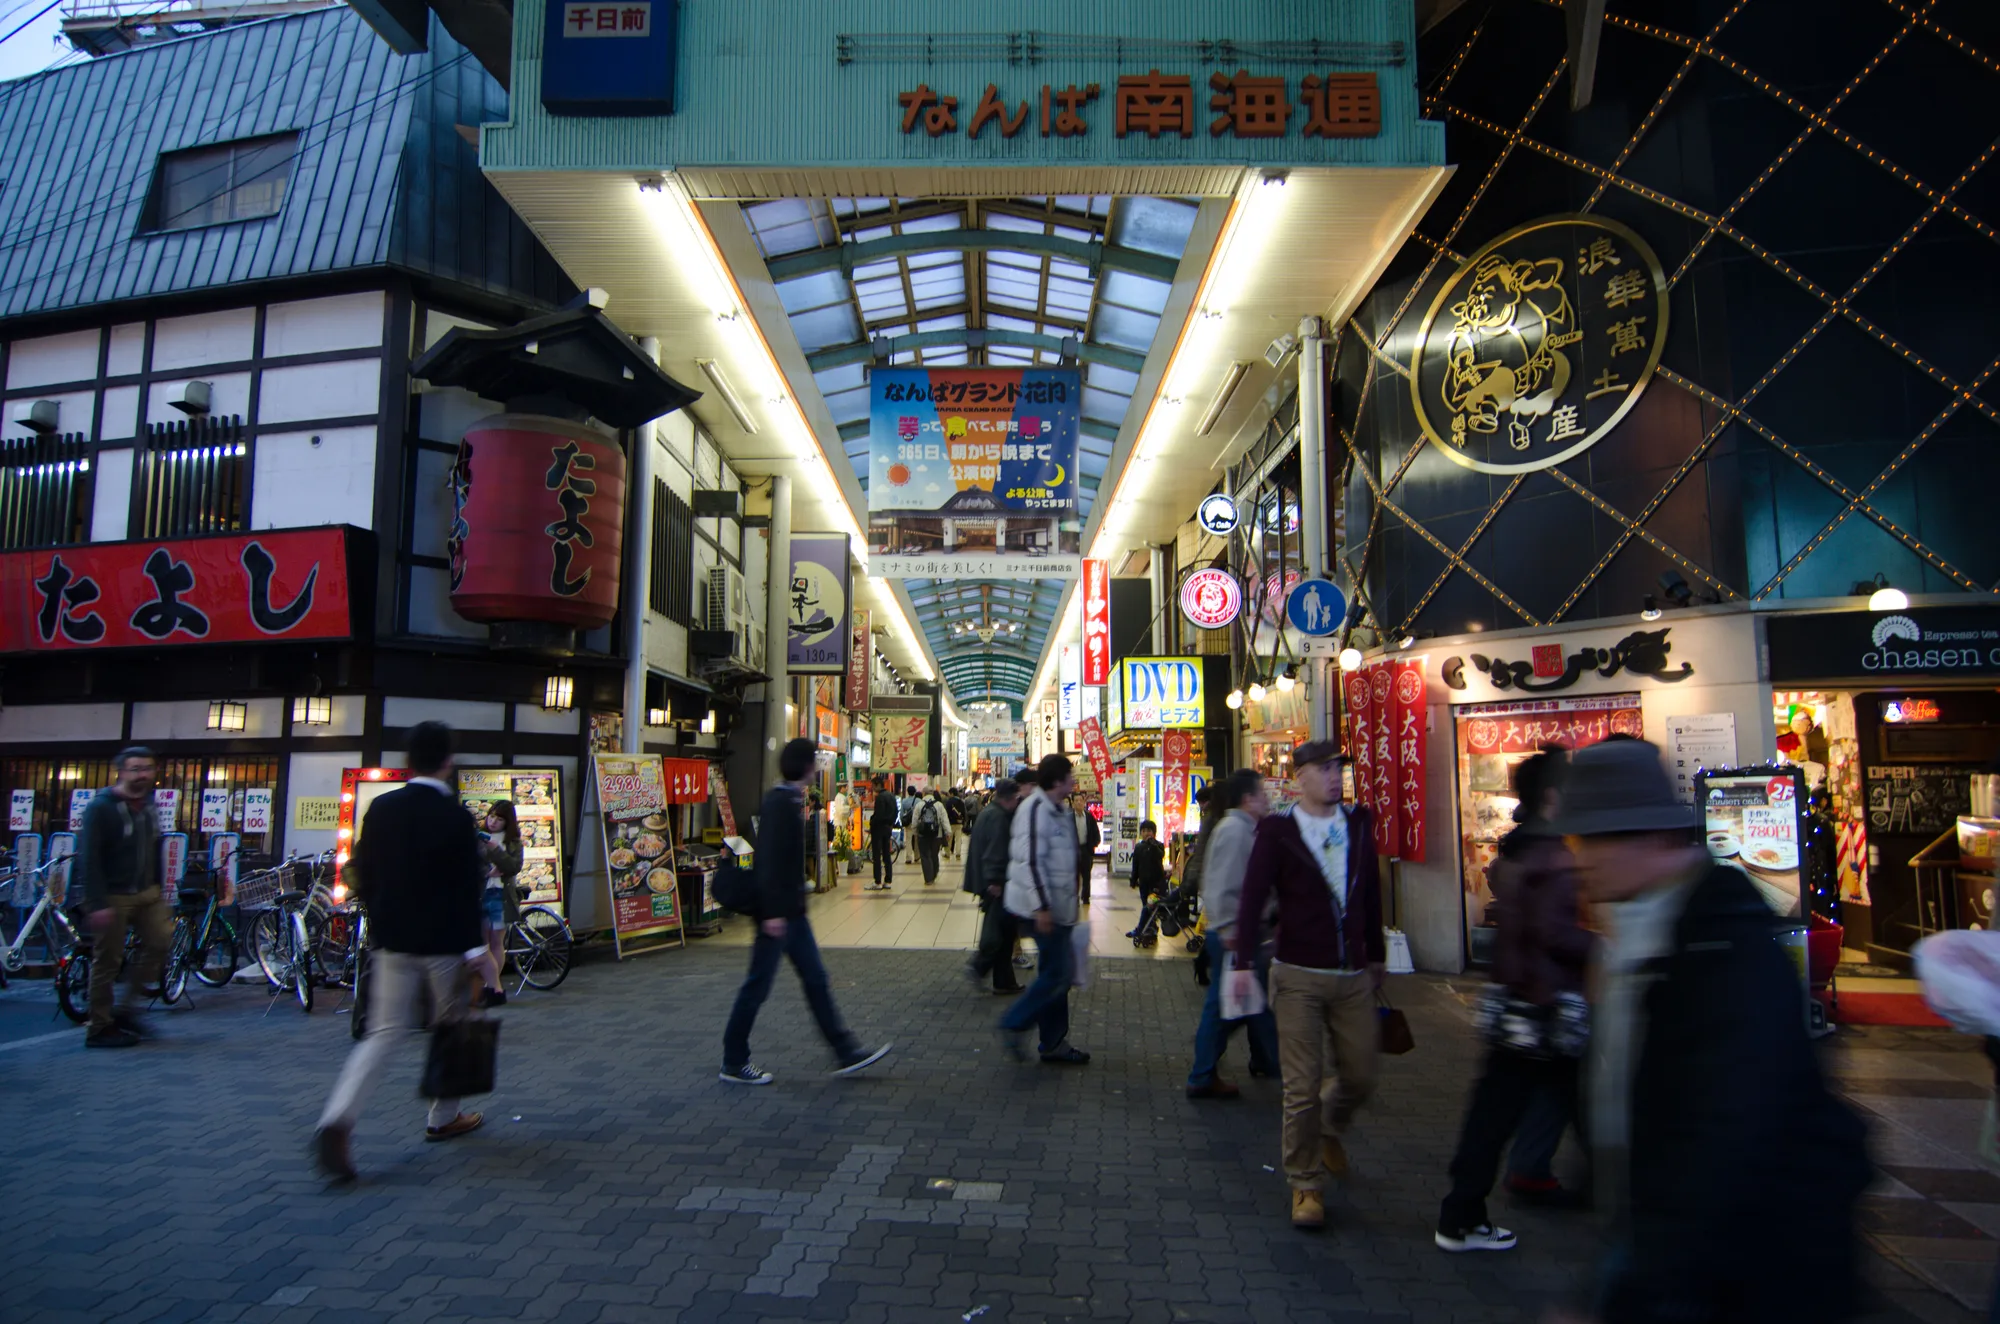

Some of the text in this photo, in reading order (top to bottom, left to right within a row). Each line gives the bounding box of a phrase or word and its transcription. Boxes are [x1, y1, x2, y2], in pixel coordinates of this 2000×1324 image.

[568, 8, 646, 31] 千日前
[899, 68, 1382, 139] なんば南海通
[885, 381, 1066, 404] なんばグランド花月
[898, 443, 1052, 461] 365日、朝から晩まで
[948, 464, 1002, 481] 公演中!
[1006, 488, 1054, 498] よる公演も
[545, 440, 597, 597] たよし
[879, 562, 993, 574] ミナミの街を美しく!
[1006, 564, 1073, 572] ミナミ千日前商店会
[35, 540, 320, 644] たよし
[1086, 599, 1107, 657] ゆかり
[1924, 631, 1978, 641] Espresso
[805, 649, 837, 662] 130円
[1862, 647, 1982, 670] chasen
[1128, 662, 1199, 703] DVD
[1160, 707, 1200, 724] ビデオ
[1901, 700, 1939, 719] Coffee
[905, 716, 927, 747] タイ
[1502, 714, 1608, 745] 大阪みやげ
[878, 717, 889, 768] マッサージ
[890, 736, 912, 770] 古式
[1374, 708, 1392, 846] 大阪みやげ
[1400, 709, 1421, 851] 大阪みやげ
[13, 795, 33, 804] 串かつ
[204, 794, 227, 804] 串かつ
[247, 794, 271, 804] おでん
[1771, 783, 1796, 800] 2F
[1748, 825, 1791, 838] 780円
